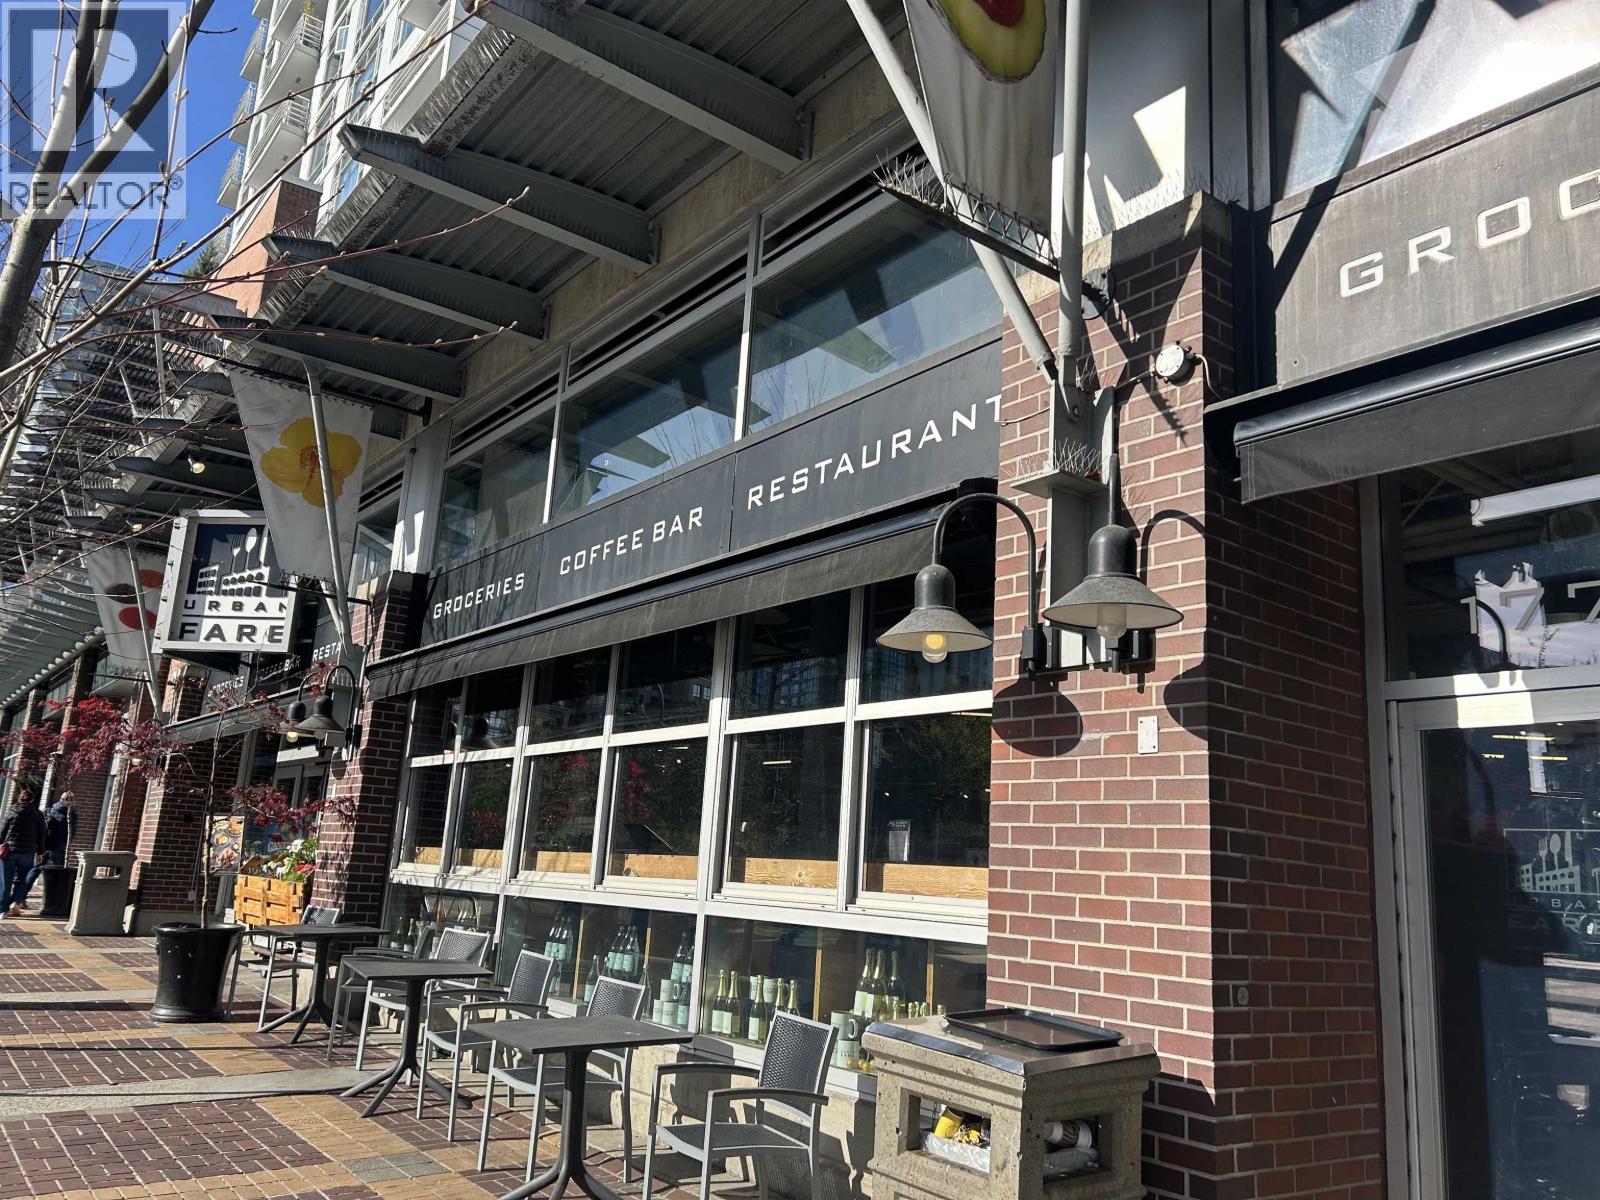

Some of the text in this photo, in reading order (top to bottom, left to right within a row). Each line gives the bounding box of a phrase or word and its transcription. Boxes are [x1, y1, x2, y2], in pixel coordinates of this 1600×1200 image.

[1339, 168, 1600, 298] GROC
[432, 394, 1002, 620] GROCERIES COFFEE BAR RESTAURANT
[178, 622, 285, 644] FARE
[183, 599, 287, 613] URBAN
